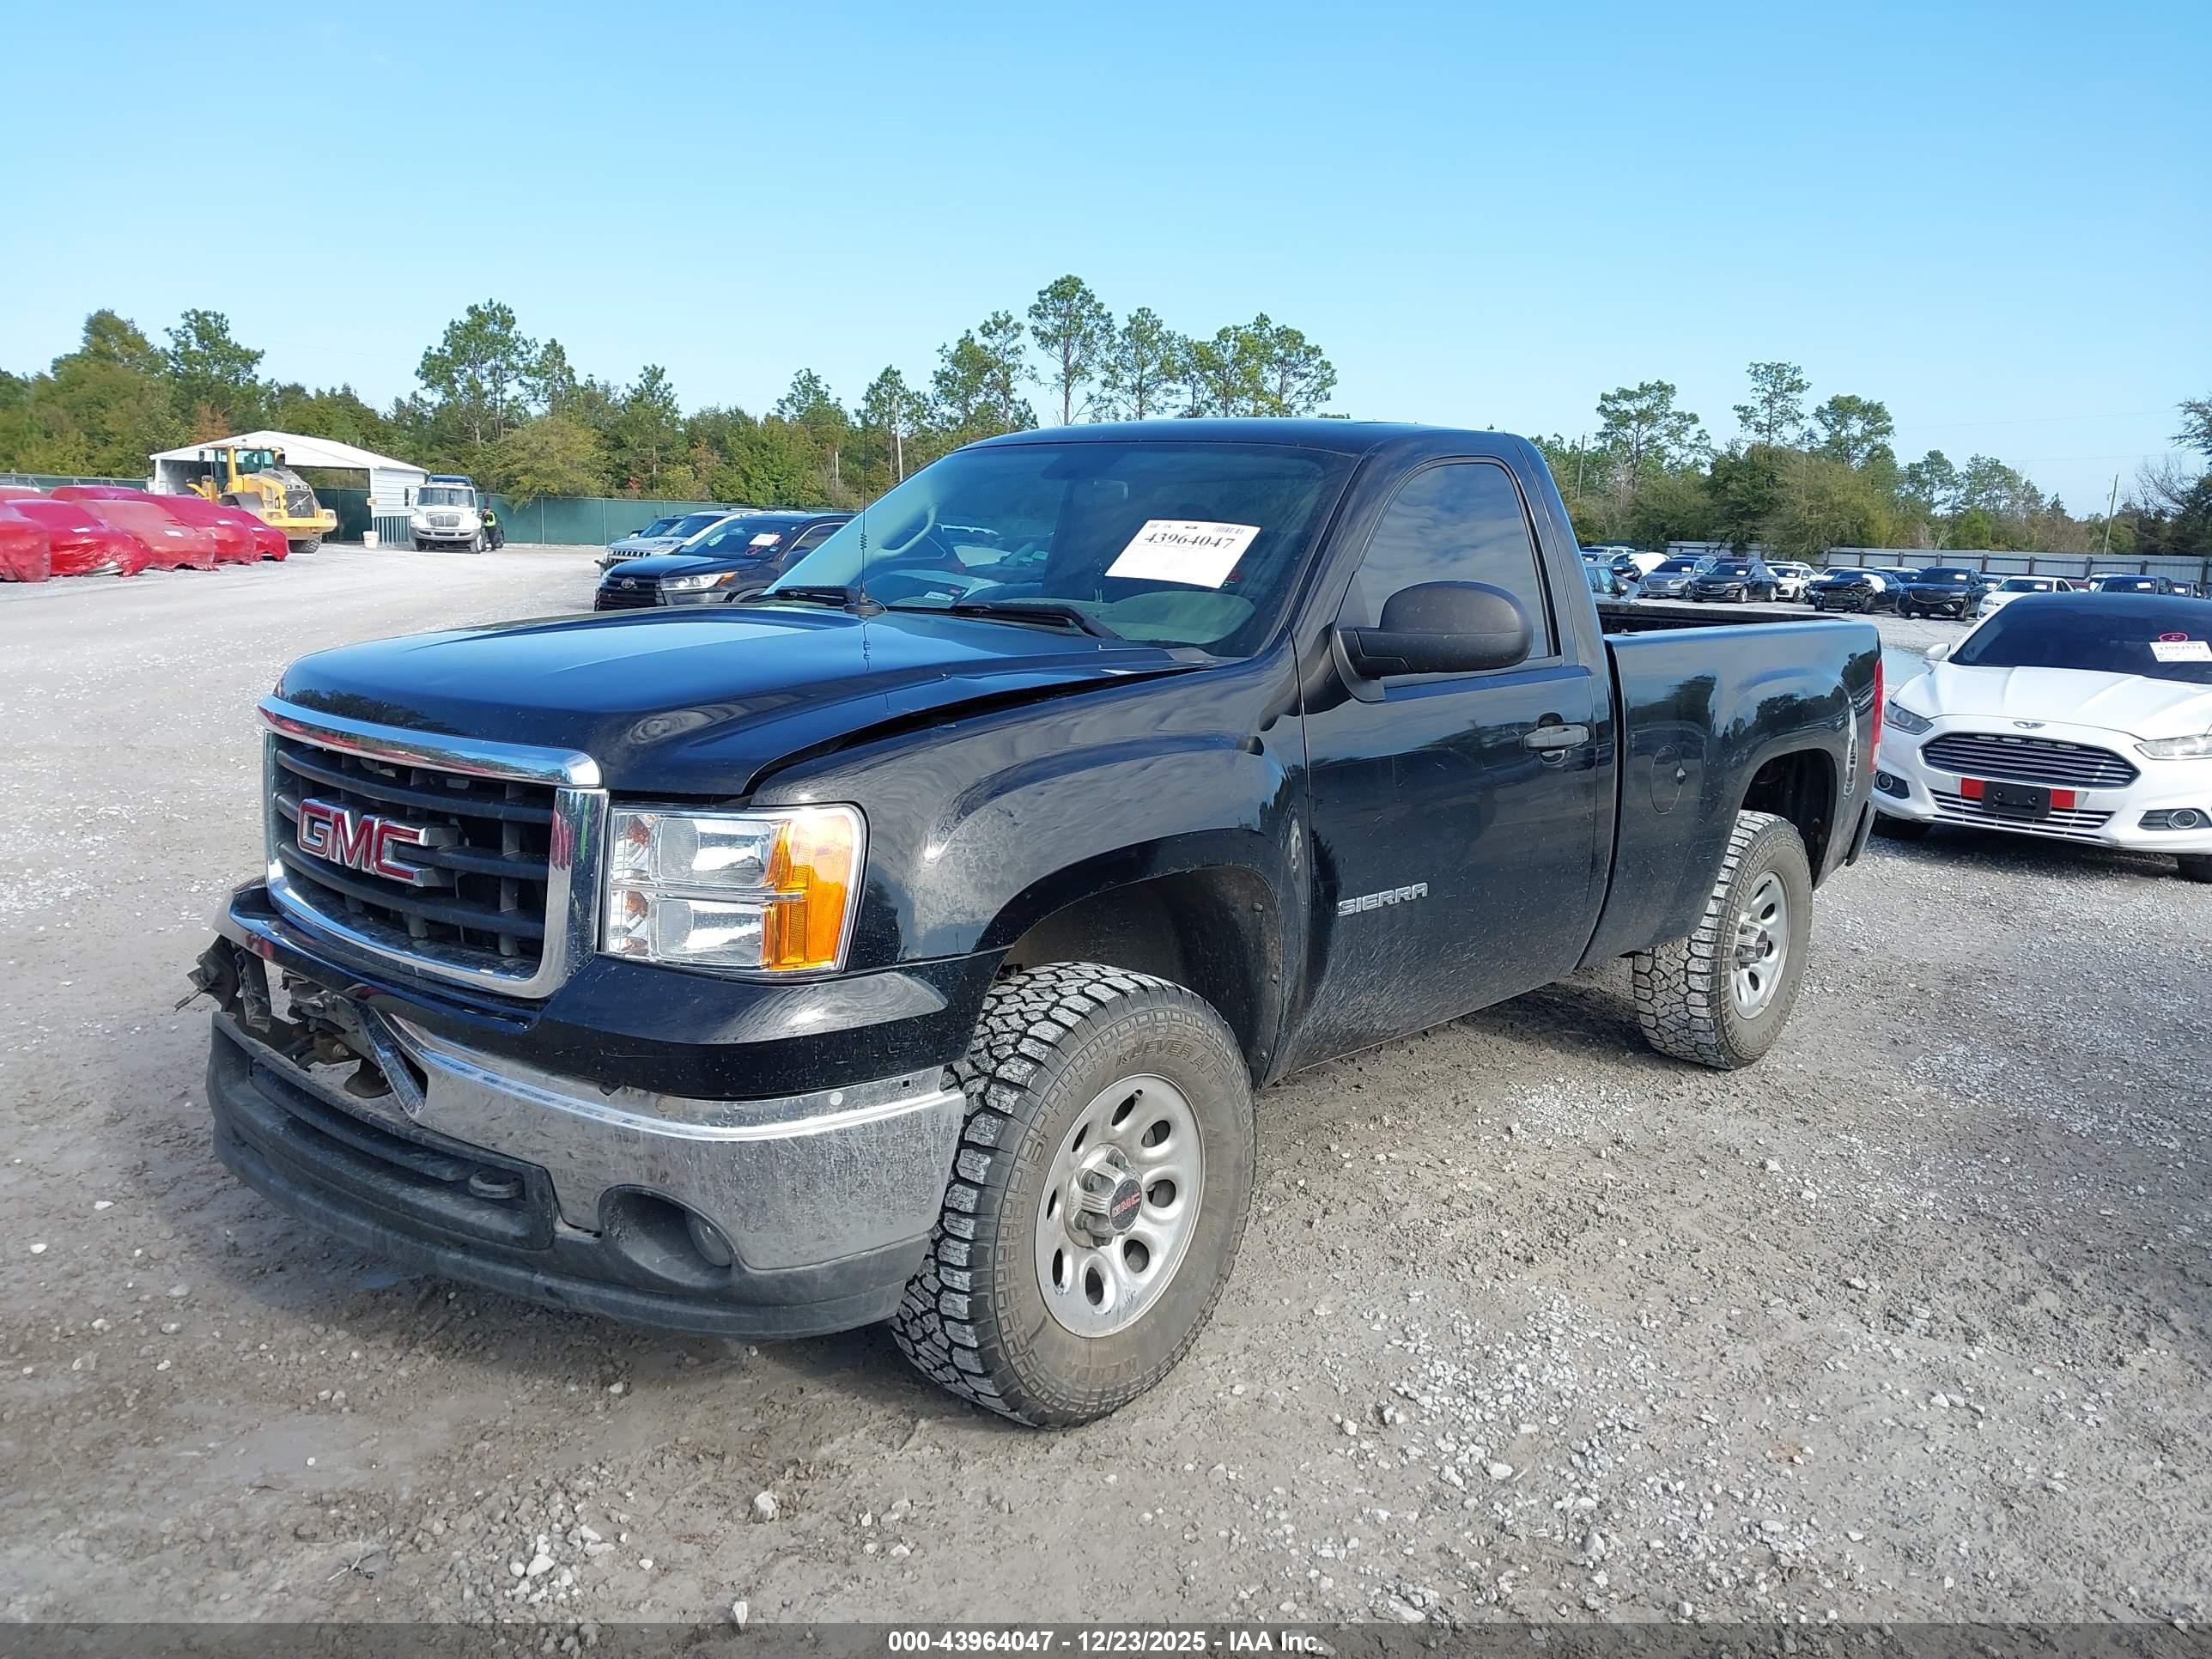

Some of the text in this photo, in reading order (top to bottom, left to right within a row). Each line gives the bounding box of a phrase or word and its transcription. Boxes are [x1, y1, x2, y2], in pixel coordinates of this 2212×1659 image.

[1145, 532, 1236, 549] 43964047
[297, 798, 427, 887] GMC
[1337, 882, 1429, 917] SIERRA
[1115, 1037, 1194, 1068] KLEVER
[1111, 1191, 1140, 1218] GMC
